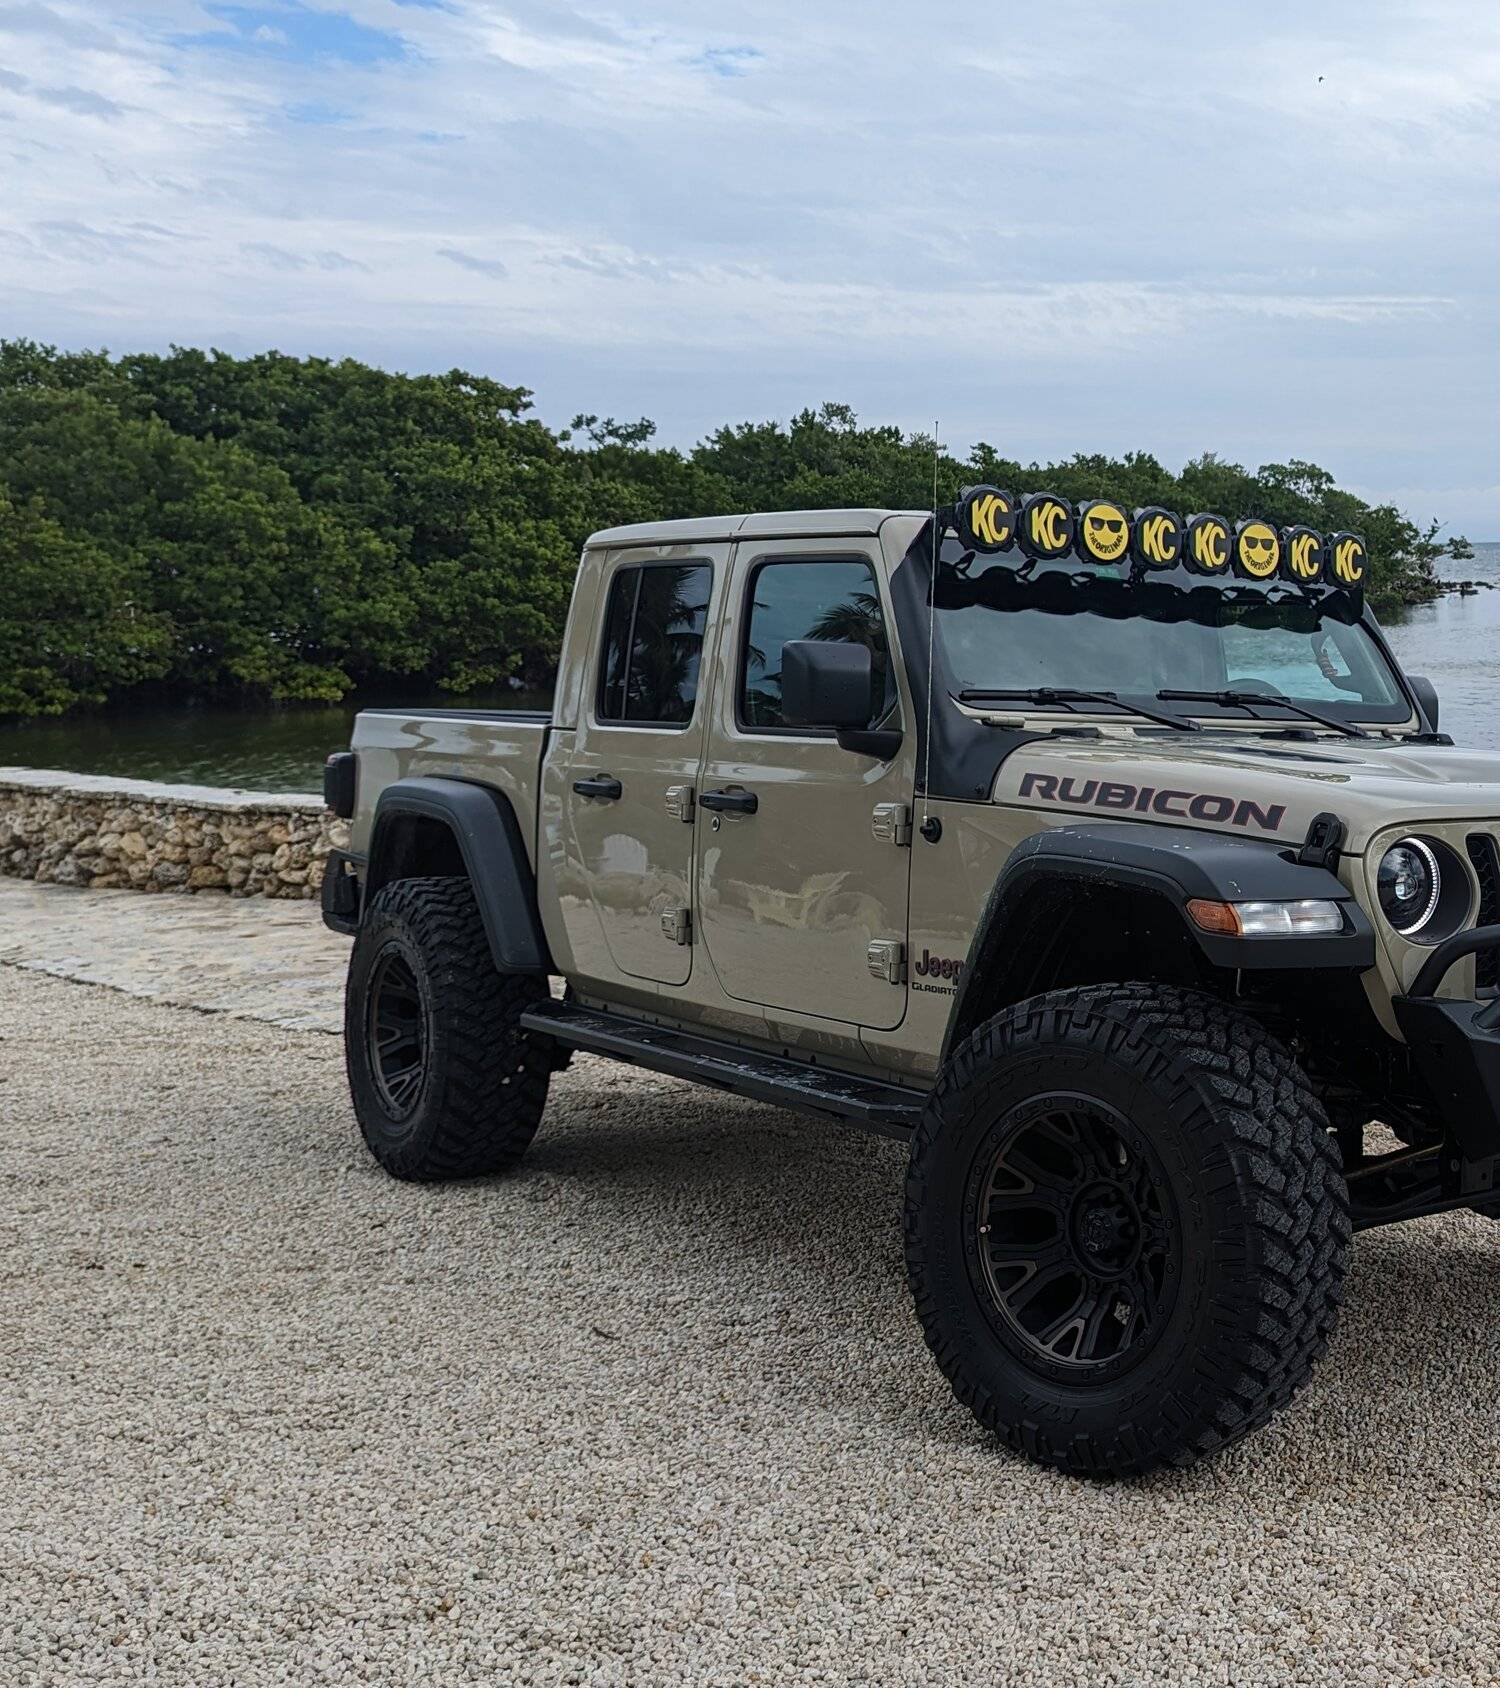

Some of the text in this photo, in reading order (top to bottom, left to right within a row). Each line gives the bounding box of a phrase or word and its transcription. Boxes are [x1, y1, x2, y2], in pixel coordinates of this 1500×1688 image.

[972, 494, 1009, 544] KC
[1031, 502, 1068, 550] KC
[1143, 515, 1176, 562] KC
[1195, 522, 1226, 568] KC
[1292, 534, 1319, 578] KC
[1336, 540, 1363, 582] KC
[1018, 772, 1287, 831] RUBICON
[911, 982, 959, 996] GLADIATO
